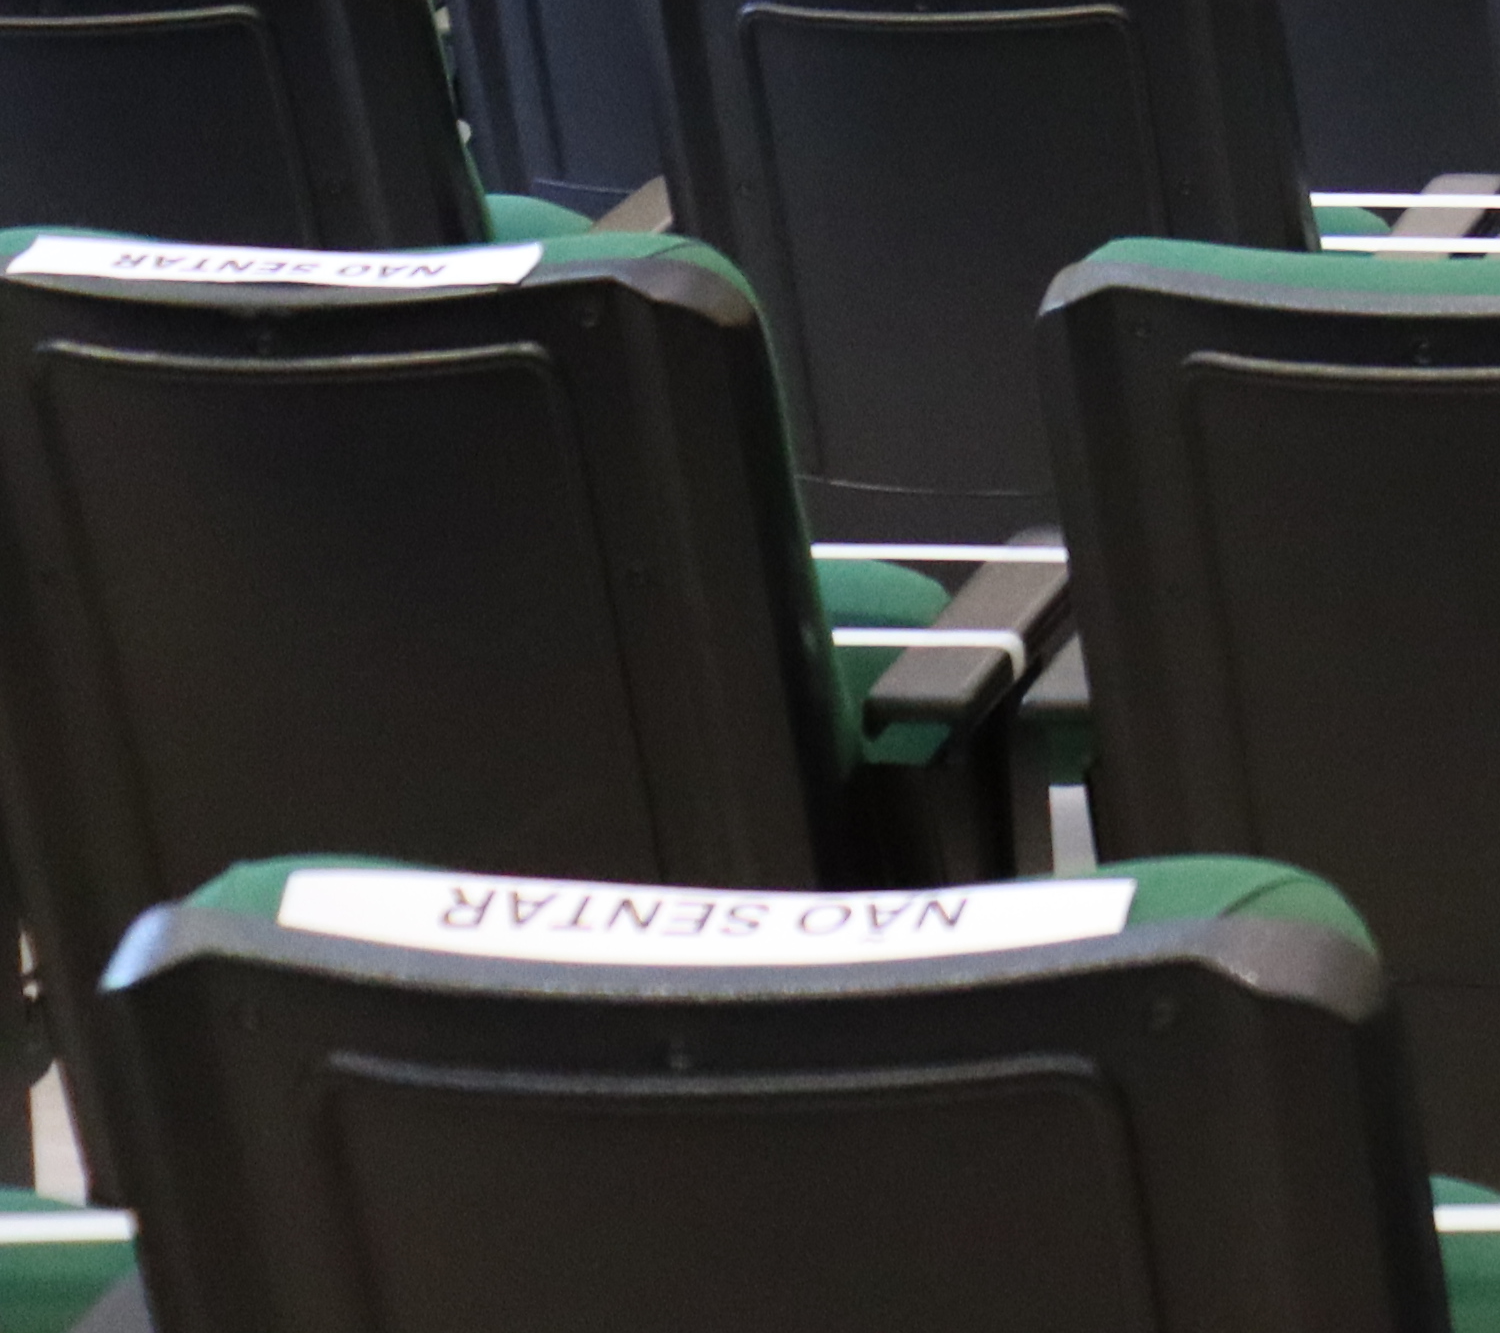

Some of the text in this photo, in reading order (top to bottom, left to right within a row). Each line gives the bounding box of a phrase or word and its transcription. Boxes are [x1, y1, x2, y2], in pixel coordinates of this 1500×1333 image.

[112, 253, 324, 275] SENTAR
[440, 887, 968, 943] NÃO SENTAR
